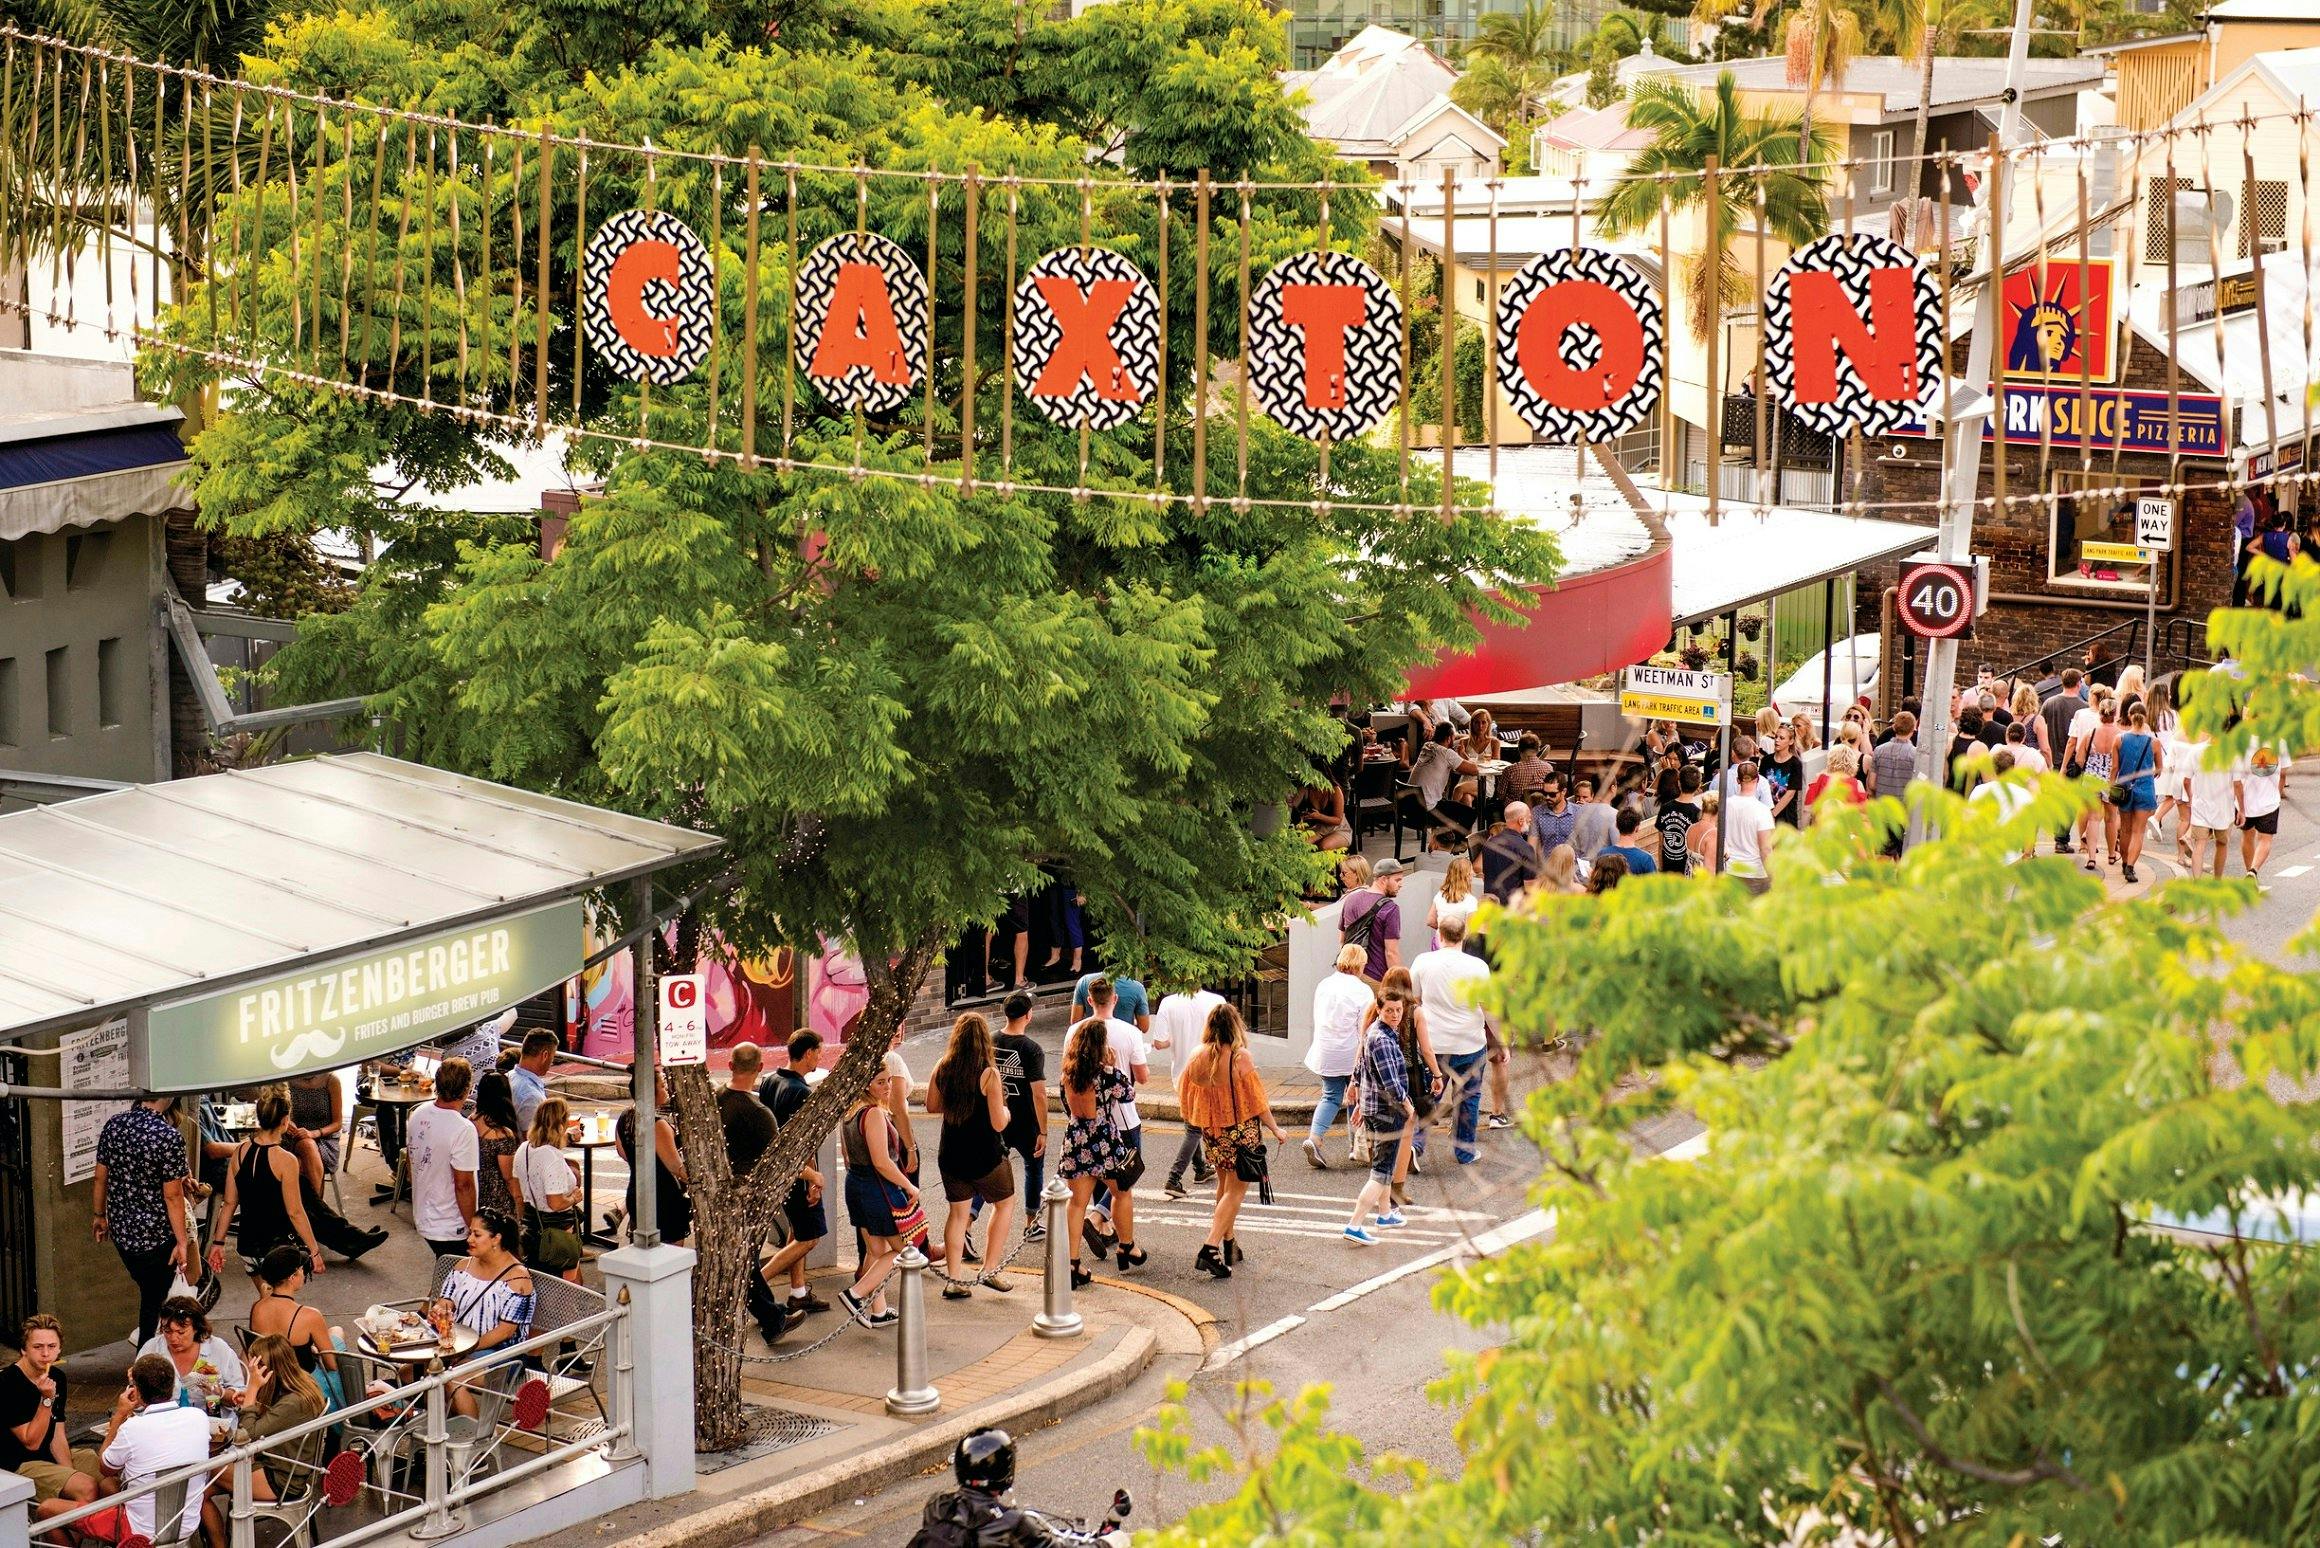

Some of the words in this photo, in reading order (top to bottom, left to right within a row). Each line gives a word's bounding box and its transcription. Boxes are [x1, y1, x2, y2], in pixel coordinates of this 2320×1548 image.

[2053, 397, 2133, 439] SLICE
[2137, 423, 2216, 445] PIZERIA
[2143, 504, 2167, 516] ONE
[2141, 519, 2168, 531] WAY
[1911, 585, 1958, 617] 40
[1634, 668, 1694, 688] WEETMAN
[1624, 699, 1641, 709] LANG
[1659, 702, 1683, 713] TRAFFIC
[1684, 705, 1701, 715] AREA
[239, 929, 510, 1043] FRITZENBERGER
[674, 982, 691, 1006] C
[354, 1018, 389, 1041] FRITES
[391, 1012, 410, 1031] AND
[412, 1001, 449, 1025] BURGER
[451, 993, 479, 1015] BREW
[480, 987, 500, 1006] PUB
